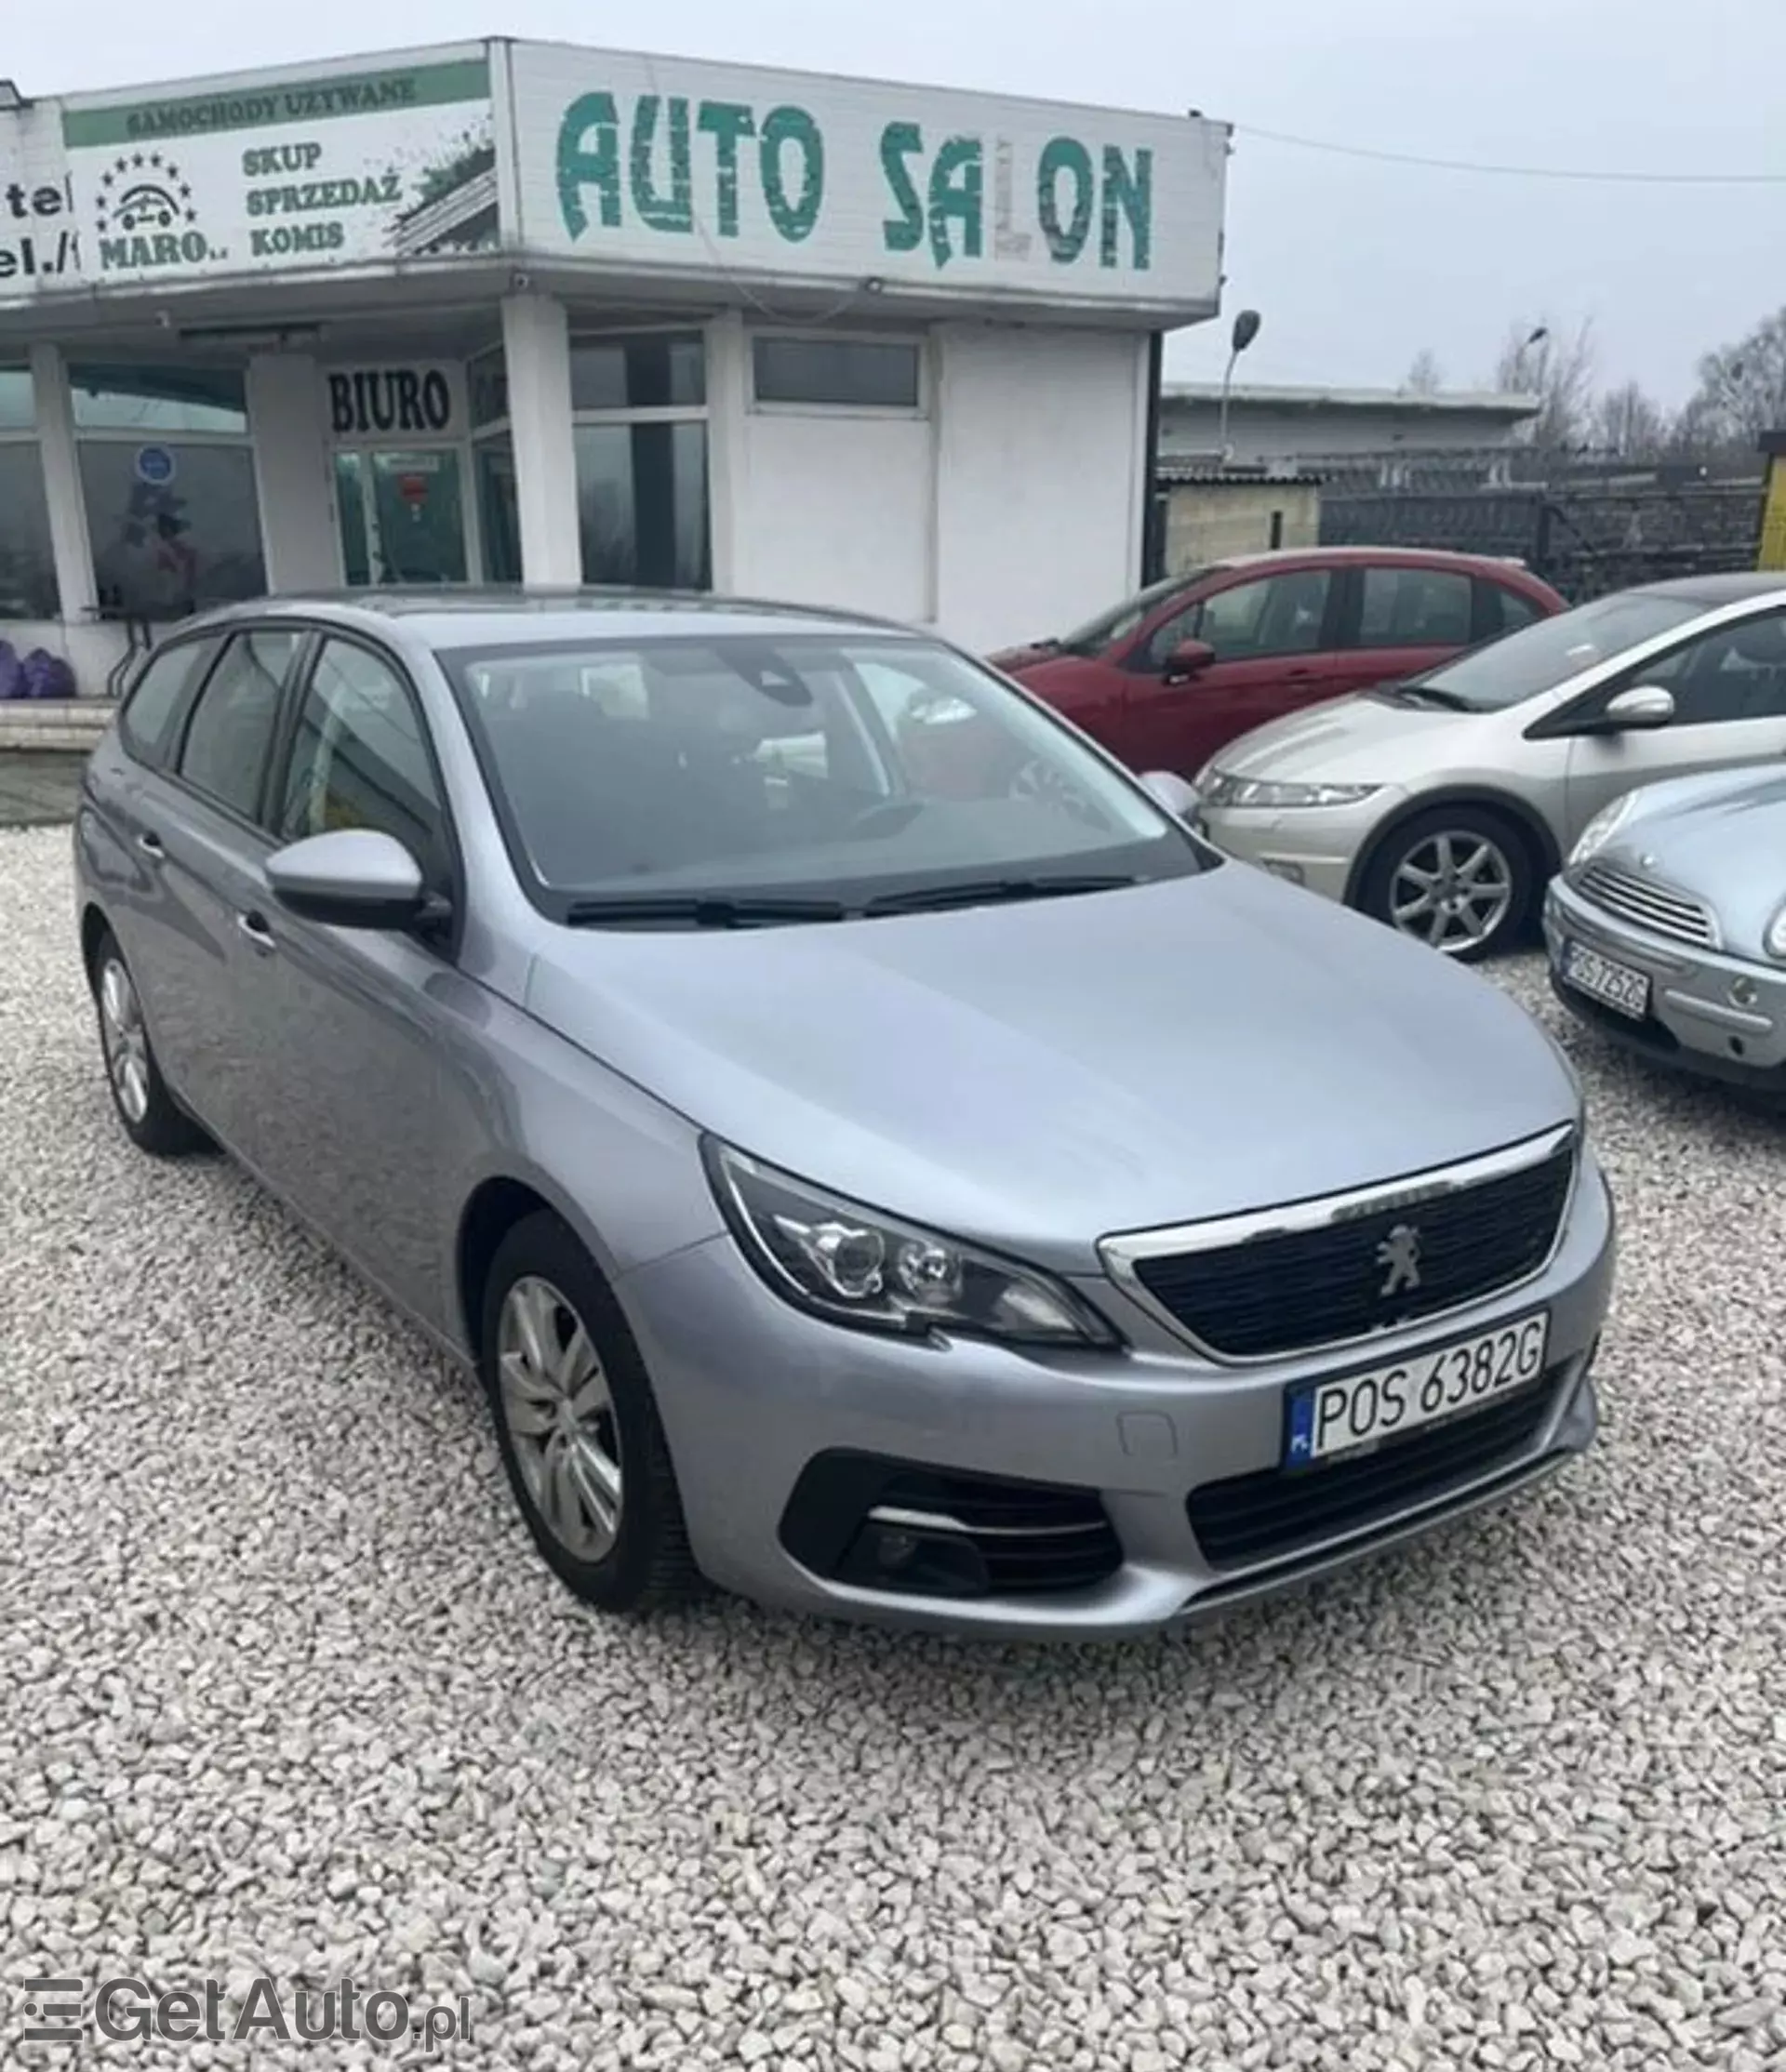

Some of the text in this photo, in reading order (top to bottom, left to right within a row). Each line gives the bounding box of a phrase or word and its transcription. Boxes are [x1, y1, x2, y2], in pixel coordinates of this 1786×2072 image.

[242, 141, 322, 176] SKUP
[555, 91, 1153, 271] AUTO SALON
[246, 166, 403, 217] SPRZEDAŻ
[249, 220, 345, 257] KOMIS
[327, 368, 450, 432] BIURO
[1317, 1321, 1541, 1448] POS 6382G
